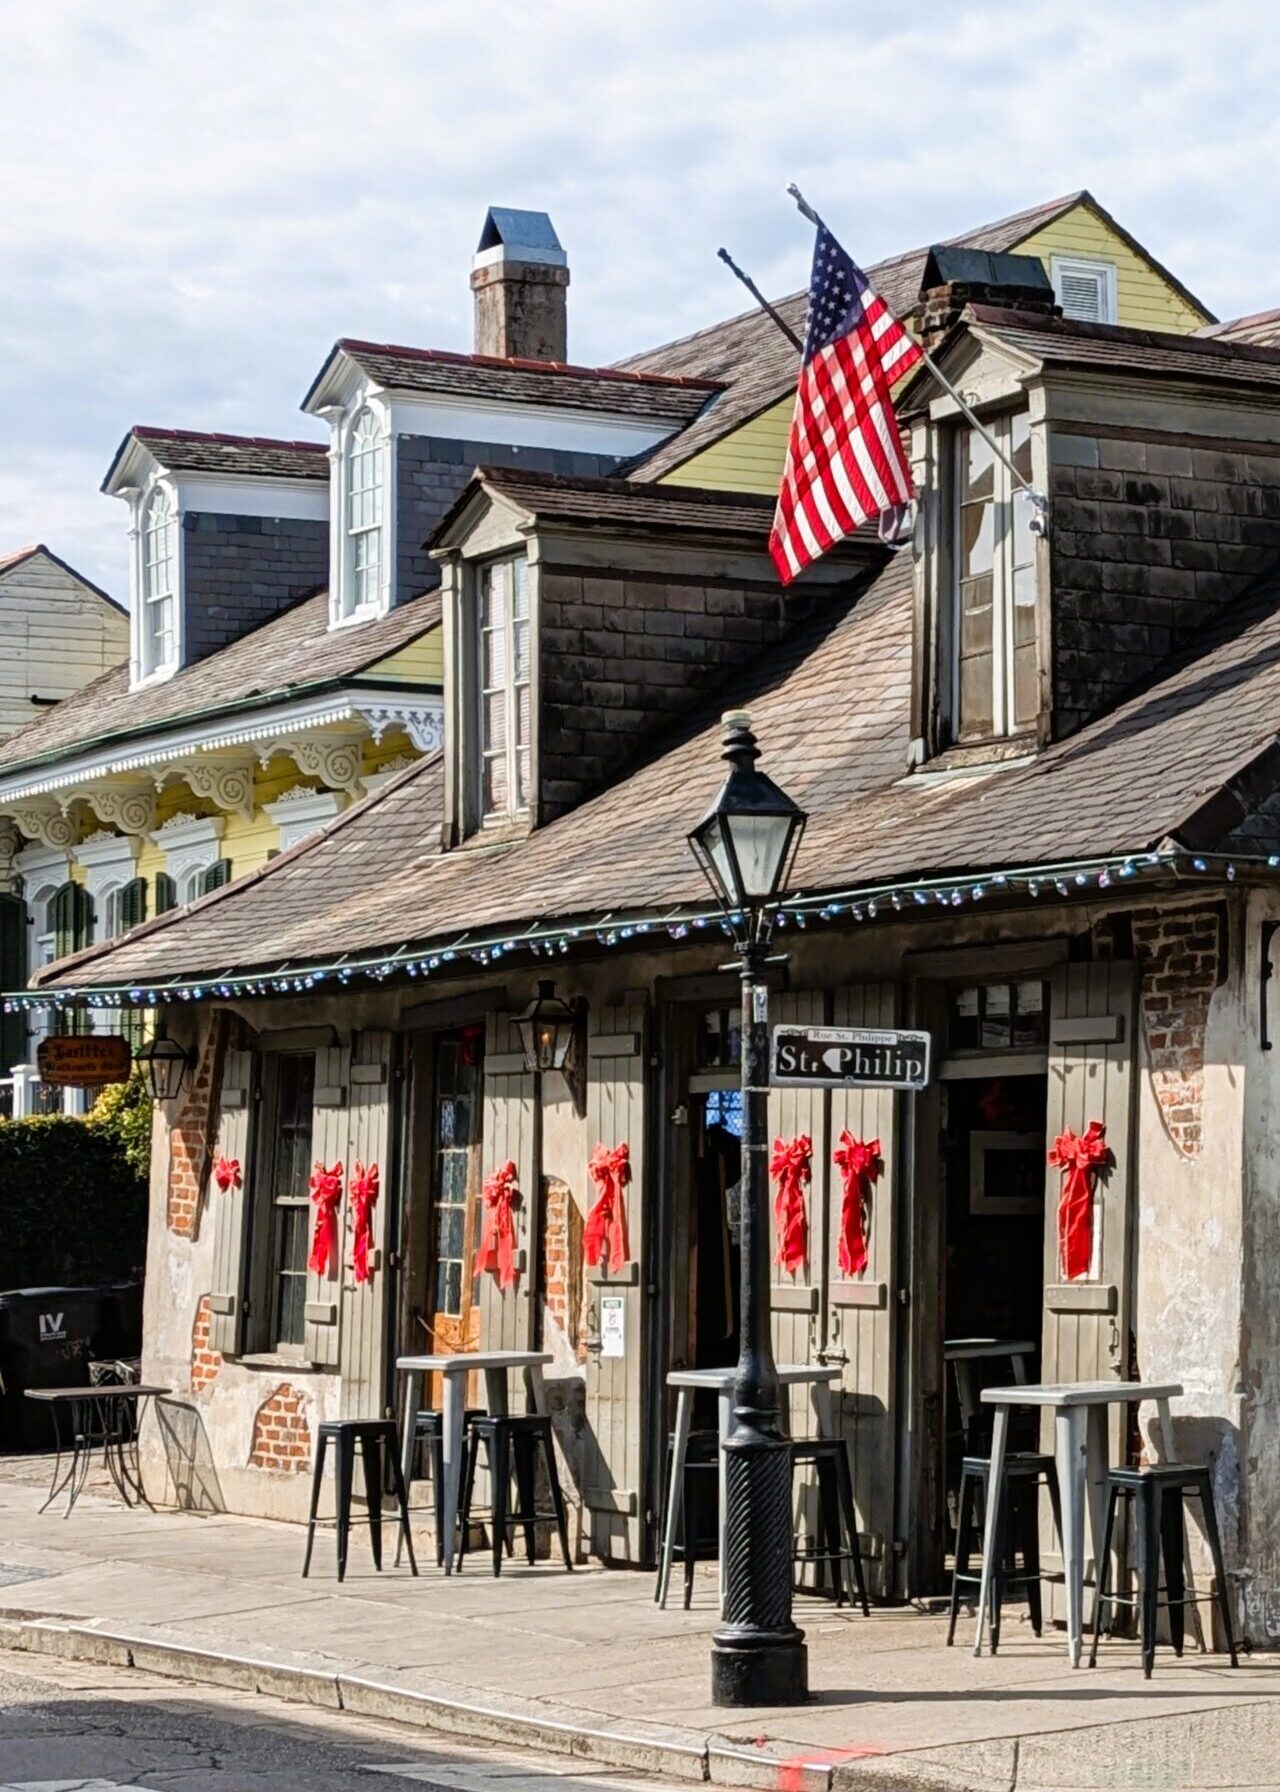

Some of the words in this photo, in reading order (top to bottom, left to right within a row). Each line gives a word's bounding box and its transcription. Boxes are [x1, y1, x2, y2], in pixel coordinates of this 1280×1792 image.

[852, 1032, 893, 1044] Philippe
[837, 1047, 922, 1082] Philip
[39, 1312, 64, 1333] IV
